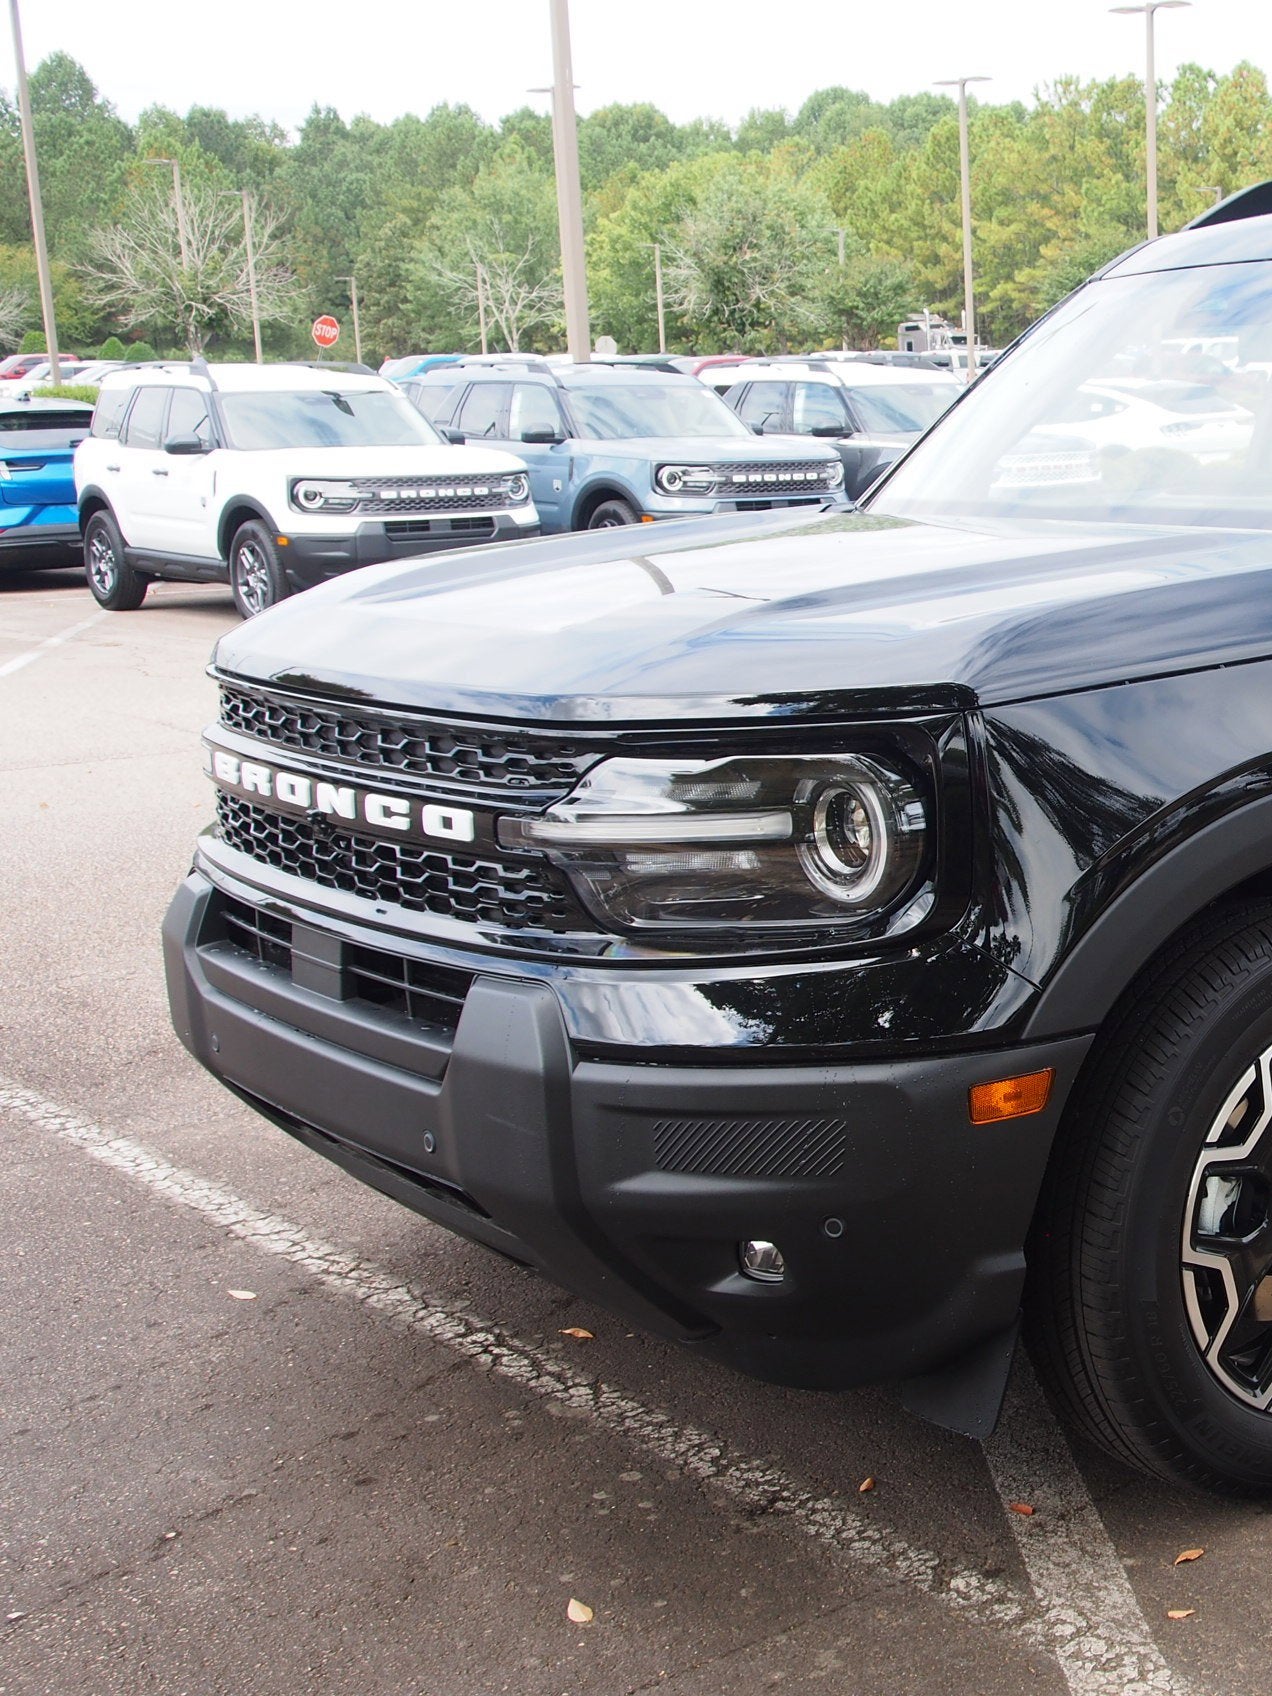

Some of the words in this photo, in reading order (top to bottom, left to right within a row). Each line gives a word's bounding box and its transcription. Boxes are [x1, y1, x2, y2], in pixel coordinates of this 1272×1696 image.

[314, 324, 338, 339] STOP
[732, 472, 818, 482] BRONCO
[380, 487, 489, 499] BRONCO
[214, 751, 475, 842] BRONCO
